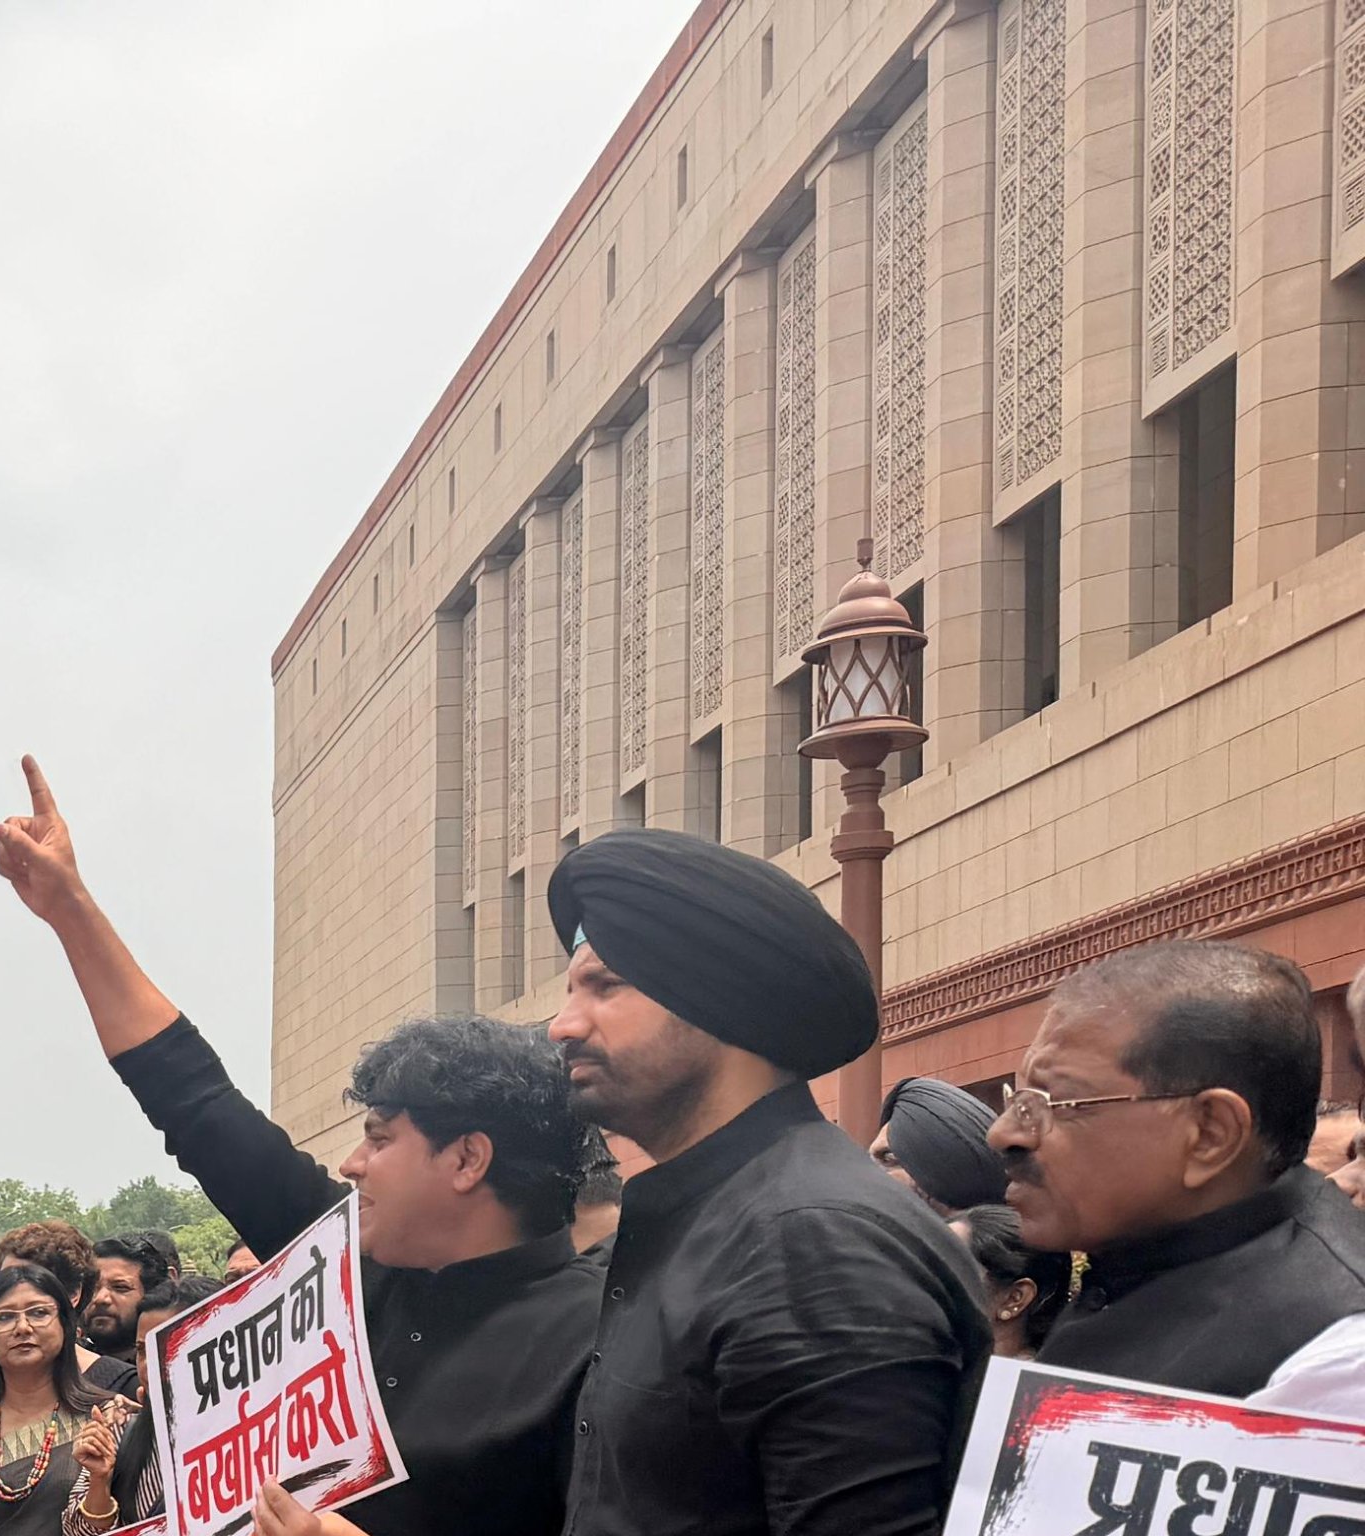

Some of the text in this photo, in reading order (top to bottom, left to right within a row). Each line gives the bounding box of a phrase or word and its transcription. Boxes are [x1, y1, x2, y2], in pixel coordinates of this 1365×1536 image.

[187, 1244, 328, 1416] प्रधान को
[182, 1328, 360, 1524] बर्खास्त करो
